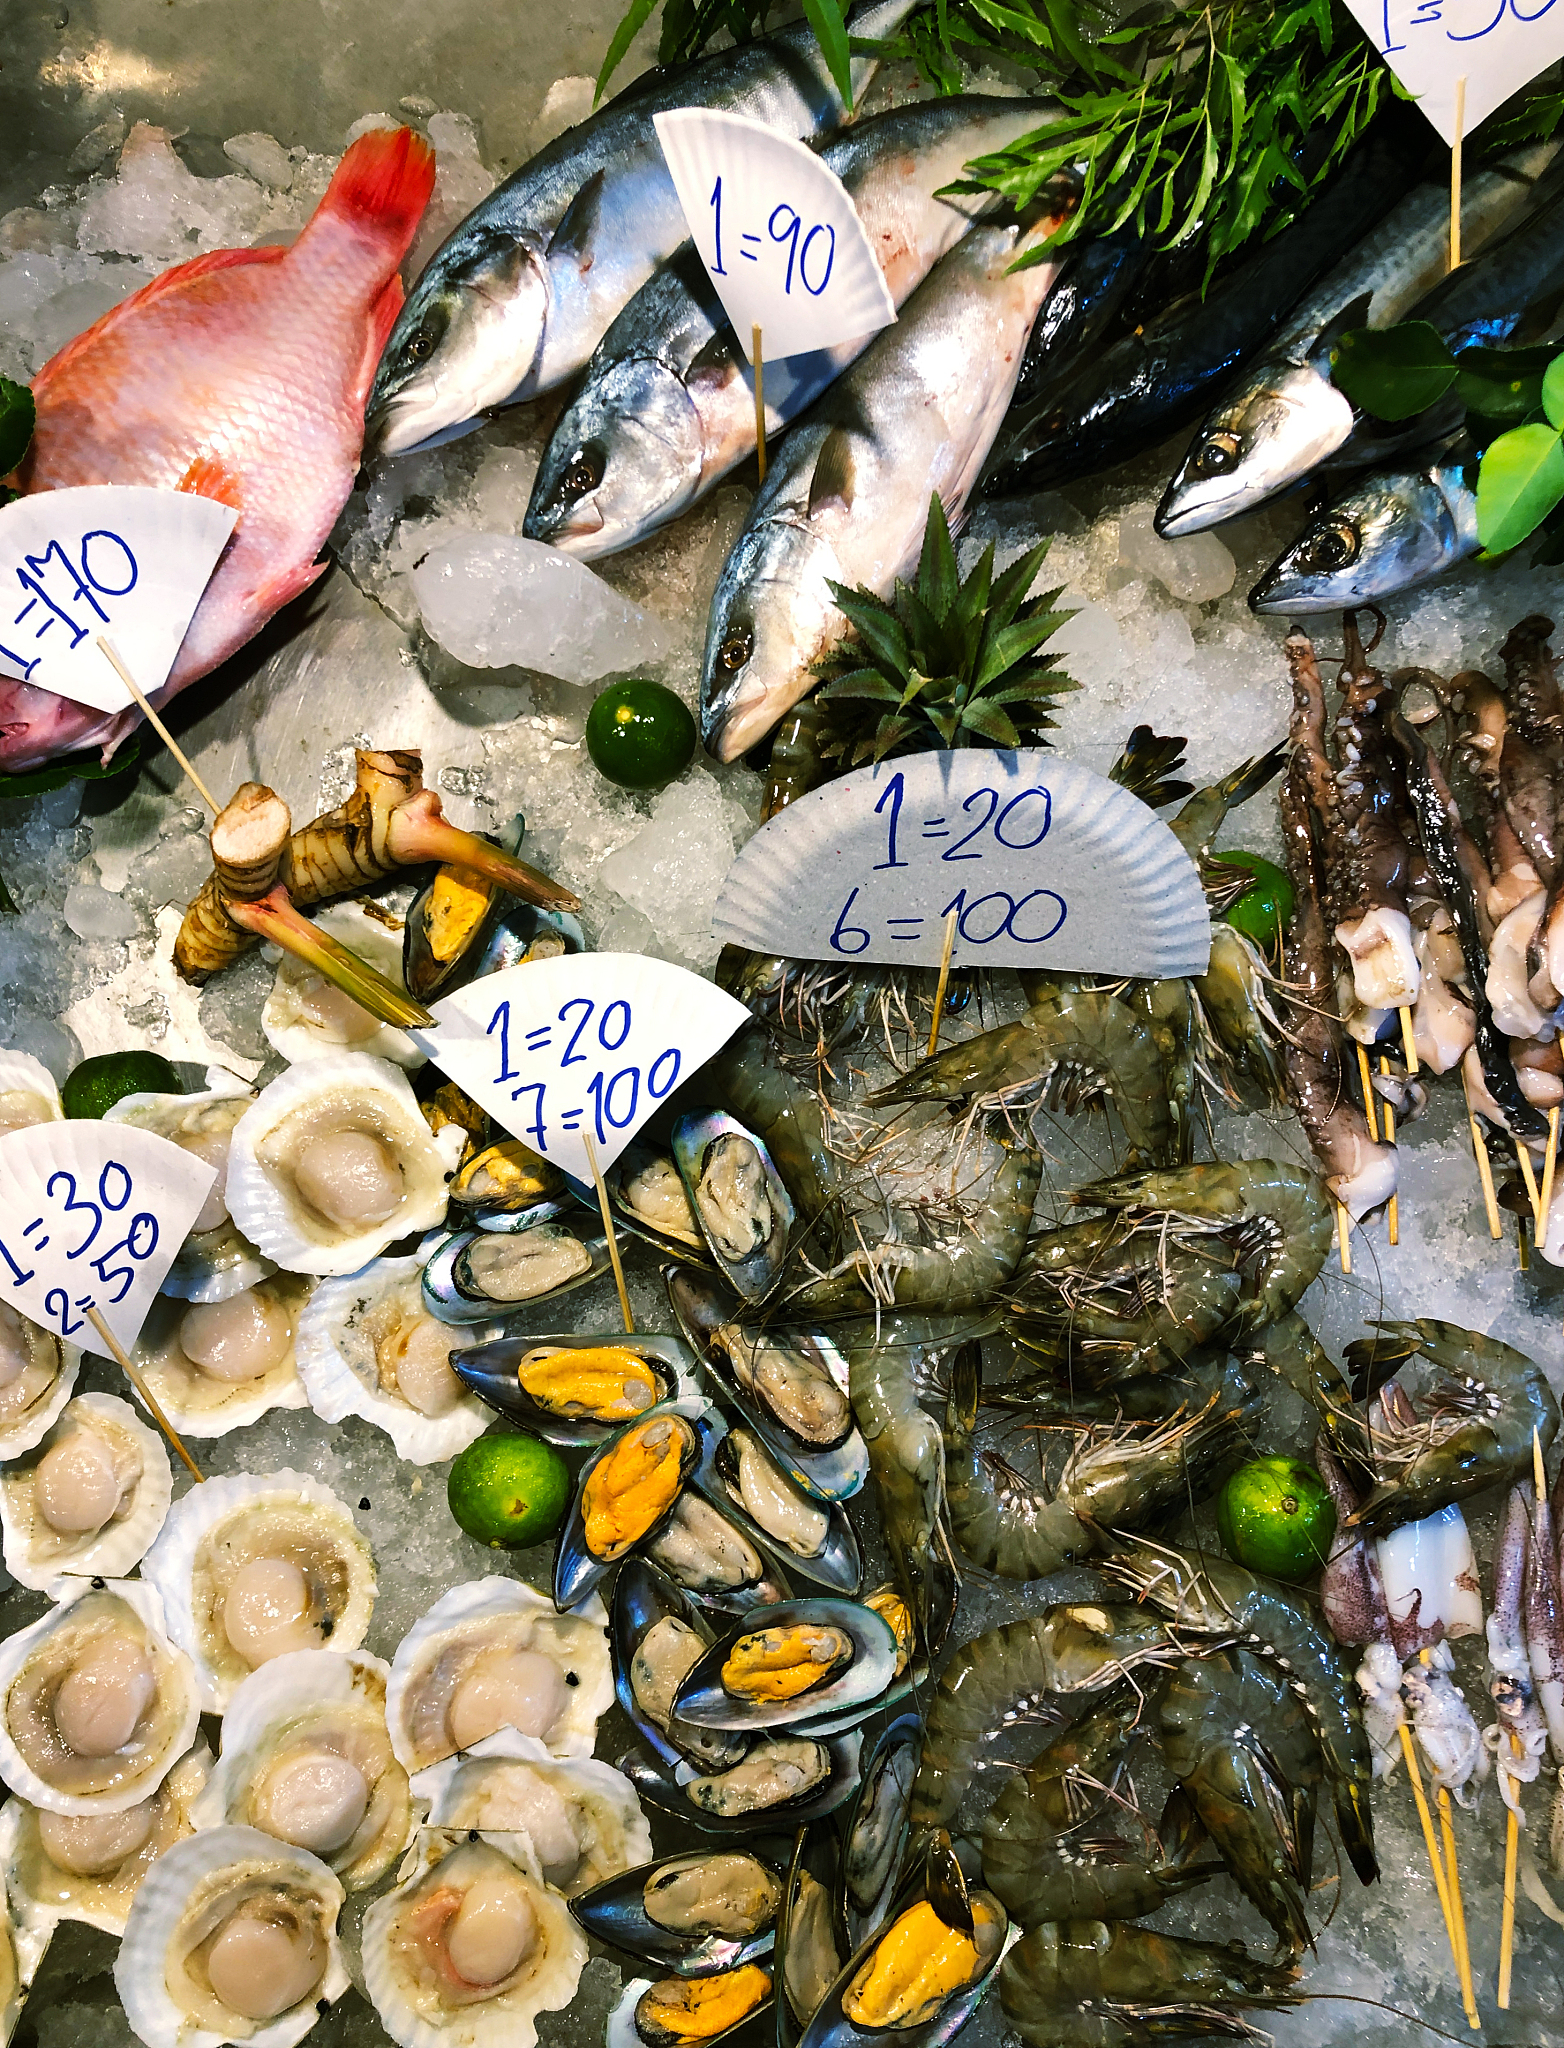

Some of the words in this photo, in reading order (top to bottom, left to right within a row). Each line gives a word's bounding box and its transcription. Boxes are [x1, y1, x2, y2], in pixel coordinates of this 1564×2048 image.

[1381, 0, 1557, 56] 1=
[710, 175, 836, 296] 1=90
[873, 772, 1052, 870] 1=20
[486, 998, 632, 1084] 1=20
[511, 1048, 681, 1152] 7=100
[44, 1212, 160, 1336] 2=50
